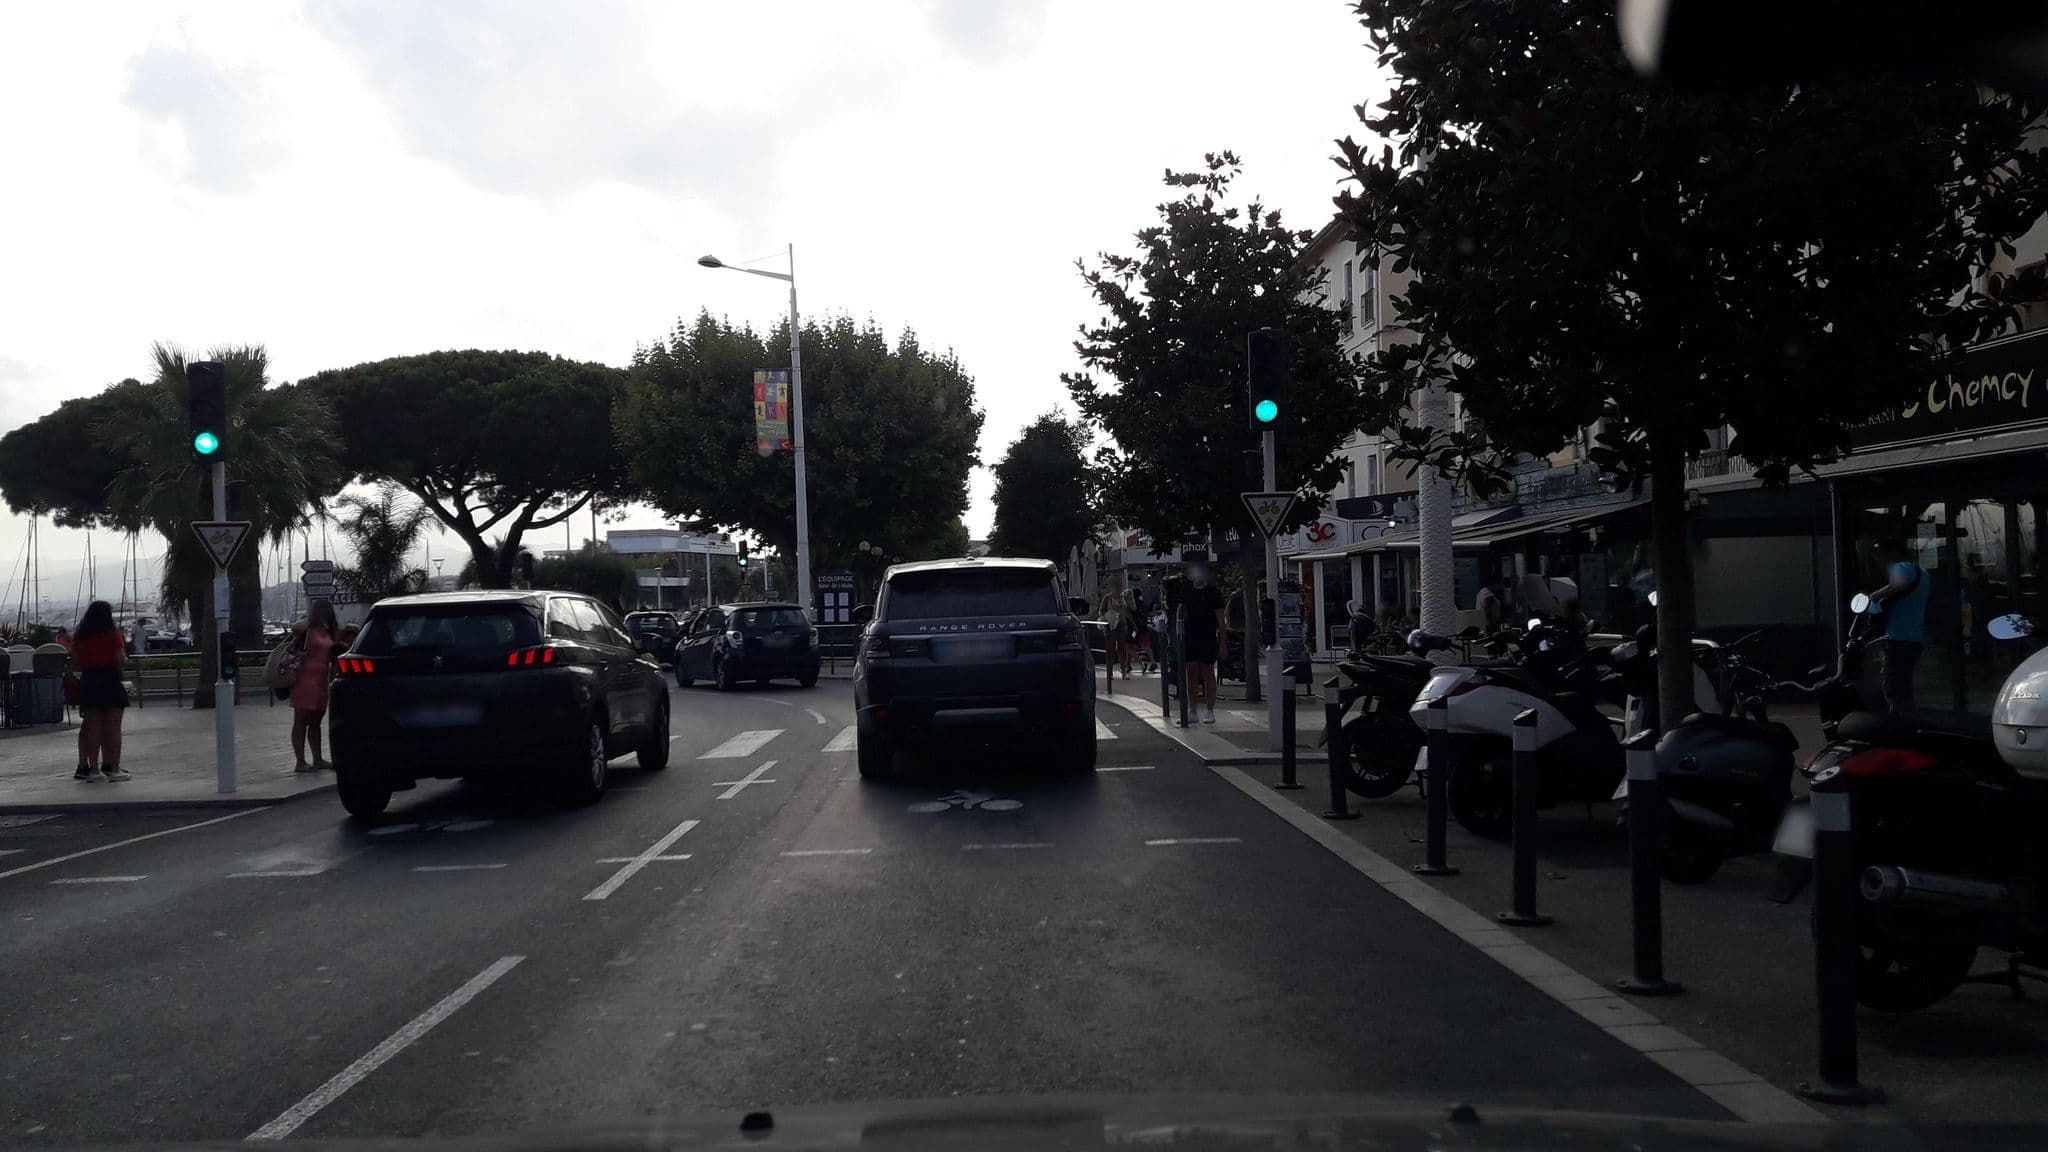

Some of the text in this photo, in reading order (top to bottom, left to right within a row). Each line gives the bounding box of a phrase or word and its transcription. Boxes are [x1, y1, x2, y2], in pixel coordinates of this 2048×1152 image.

[1182, 541, 1207, 553] phox
[919, 622, 1026, 632] RANGE ROVER
